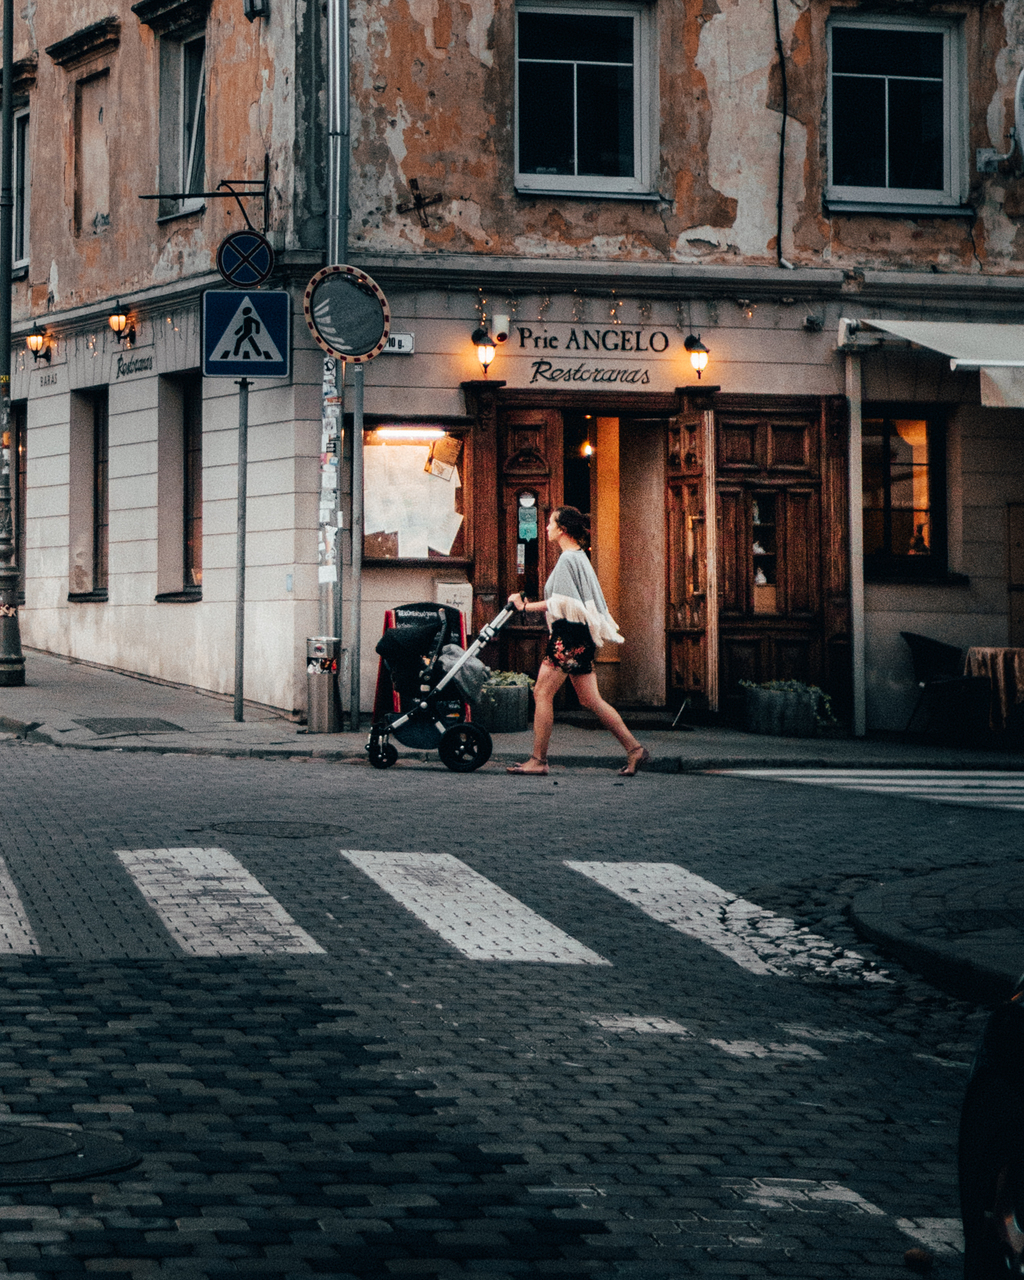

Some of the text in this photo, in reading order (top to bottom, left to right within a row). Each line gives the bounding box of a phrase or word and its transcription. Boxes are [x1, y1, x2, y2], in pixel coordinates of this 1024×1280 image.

[517, 326, 669, 353] Prie ANGELO
[40, 373, 58, 387] BARAS
[529, 356, 651, 385] Restoranas
